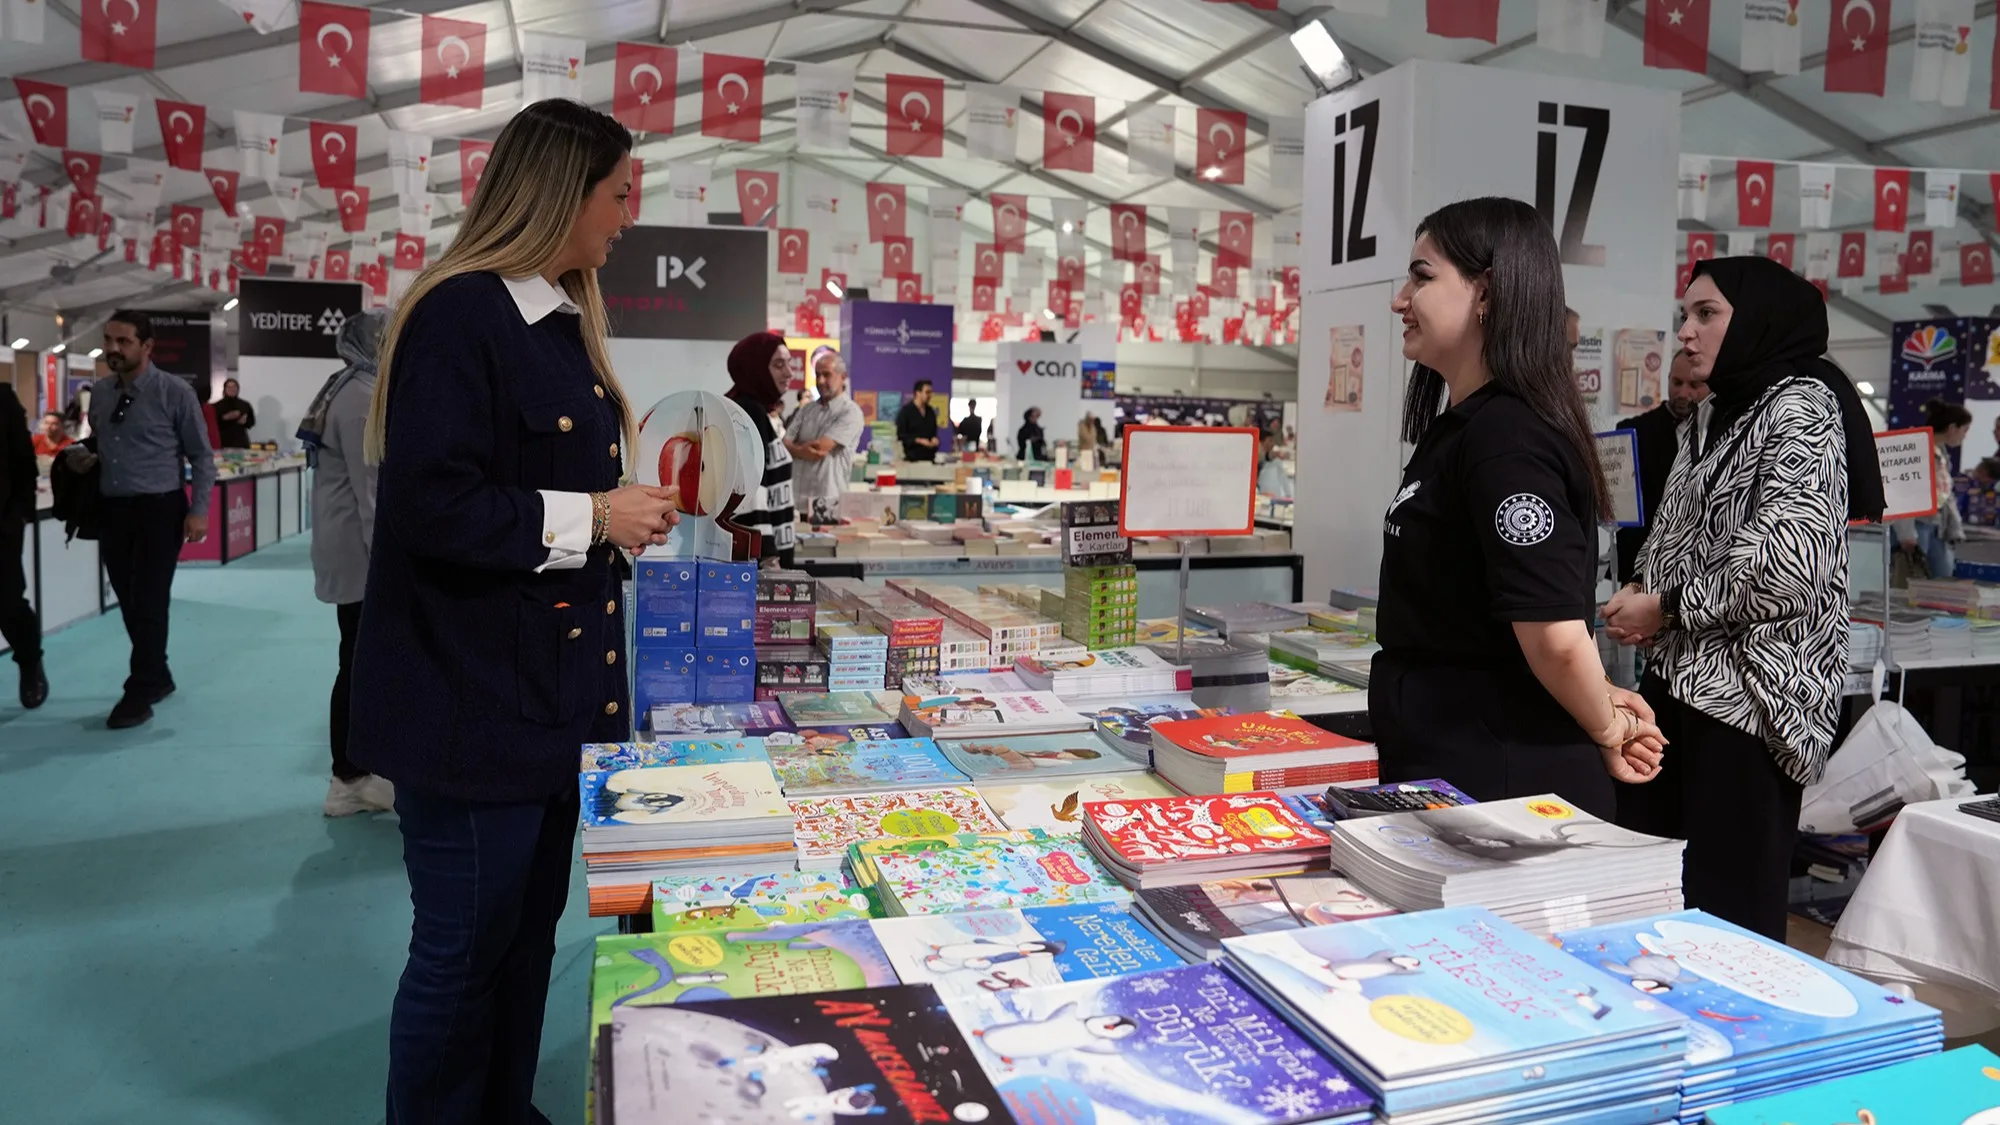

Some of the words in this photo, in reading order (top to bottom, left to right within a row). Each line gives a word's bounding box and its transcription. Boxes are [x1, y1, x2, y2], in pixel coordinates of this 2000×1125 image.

[249, 310, 312, 331] YEDİTEPE
[1034, 358, 1077, 378] can
[1881, 456, 1921, 468] KİTAPLARI
[1899, 472, 1910, 482] 45
[1912, 471, 1922, 480] TL
[1073, 530, 1120, 541] Elemen
[1068, 914, 1142, 972] Nereden
[744, 942, 787, 995] Büyük
[786, 958, 812, 973] Ne
[808, 949, 838, 990] Dinozo
[1073, 947, 1121, 978] Geli
[791, 975, 815, 995] Ka
[1406, 937, 1559, 1020] Yüksek?
[814, 1000, 892, 1027] AY
[1137, 1003, 1253, 1090] Büyük?
[1188, 1004, 1218, 1024] Ne
[1207, 1023, 1262, 1066] Kadar
[1197, 985, 1241, 1013] Bir
[1229, 1013, 1320, 1081] Milyon
